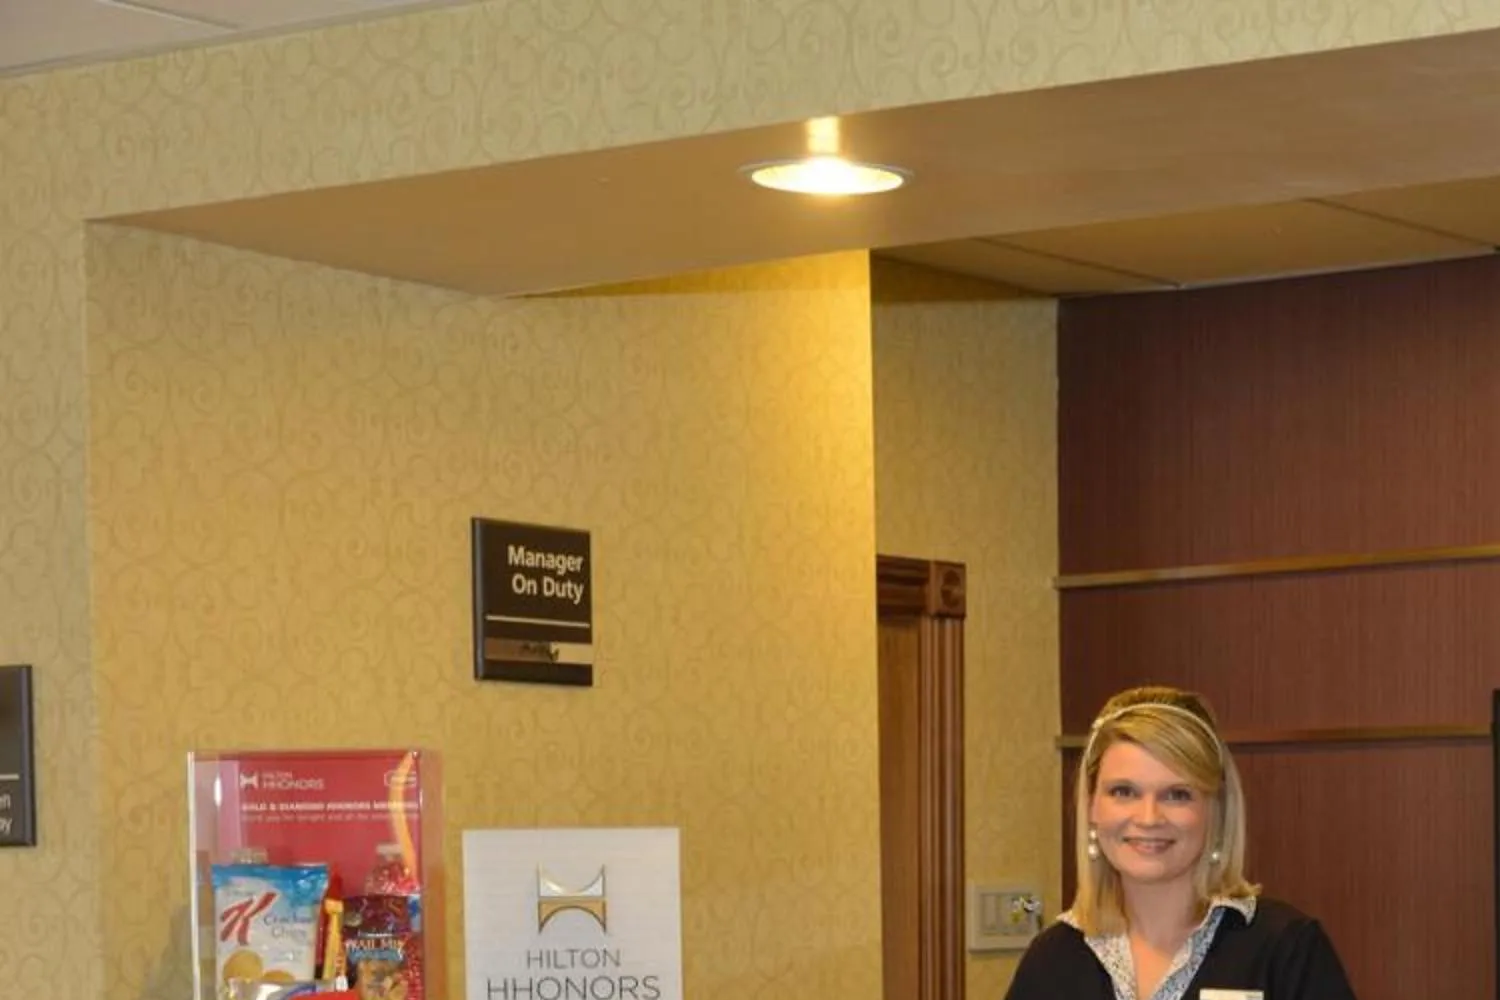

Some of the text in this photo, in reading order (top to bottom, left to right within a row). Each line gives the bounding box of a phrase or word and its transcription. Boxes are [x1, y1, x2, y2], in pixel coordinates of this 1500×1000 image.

[507, 545, 584, 576] Manager
[512, 573, 585, 605] On Duty
[526, 948, 621, 970] HILTON
